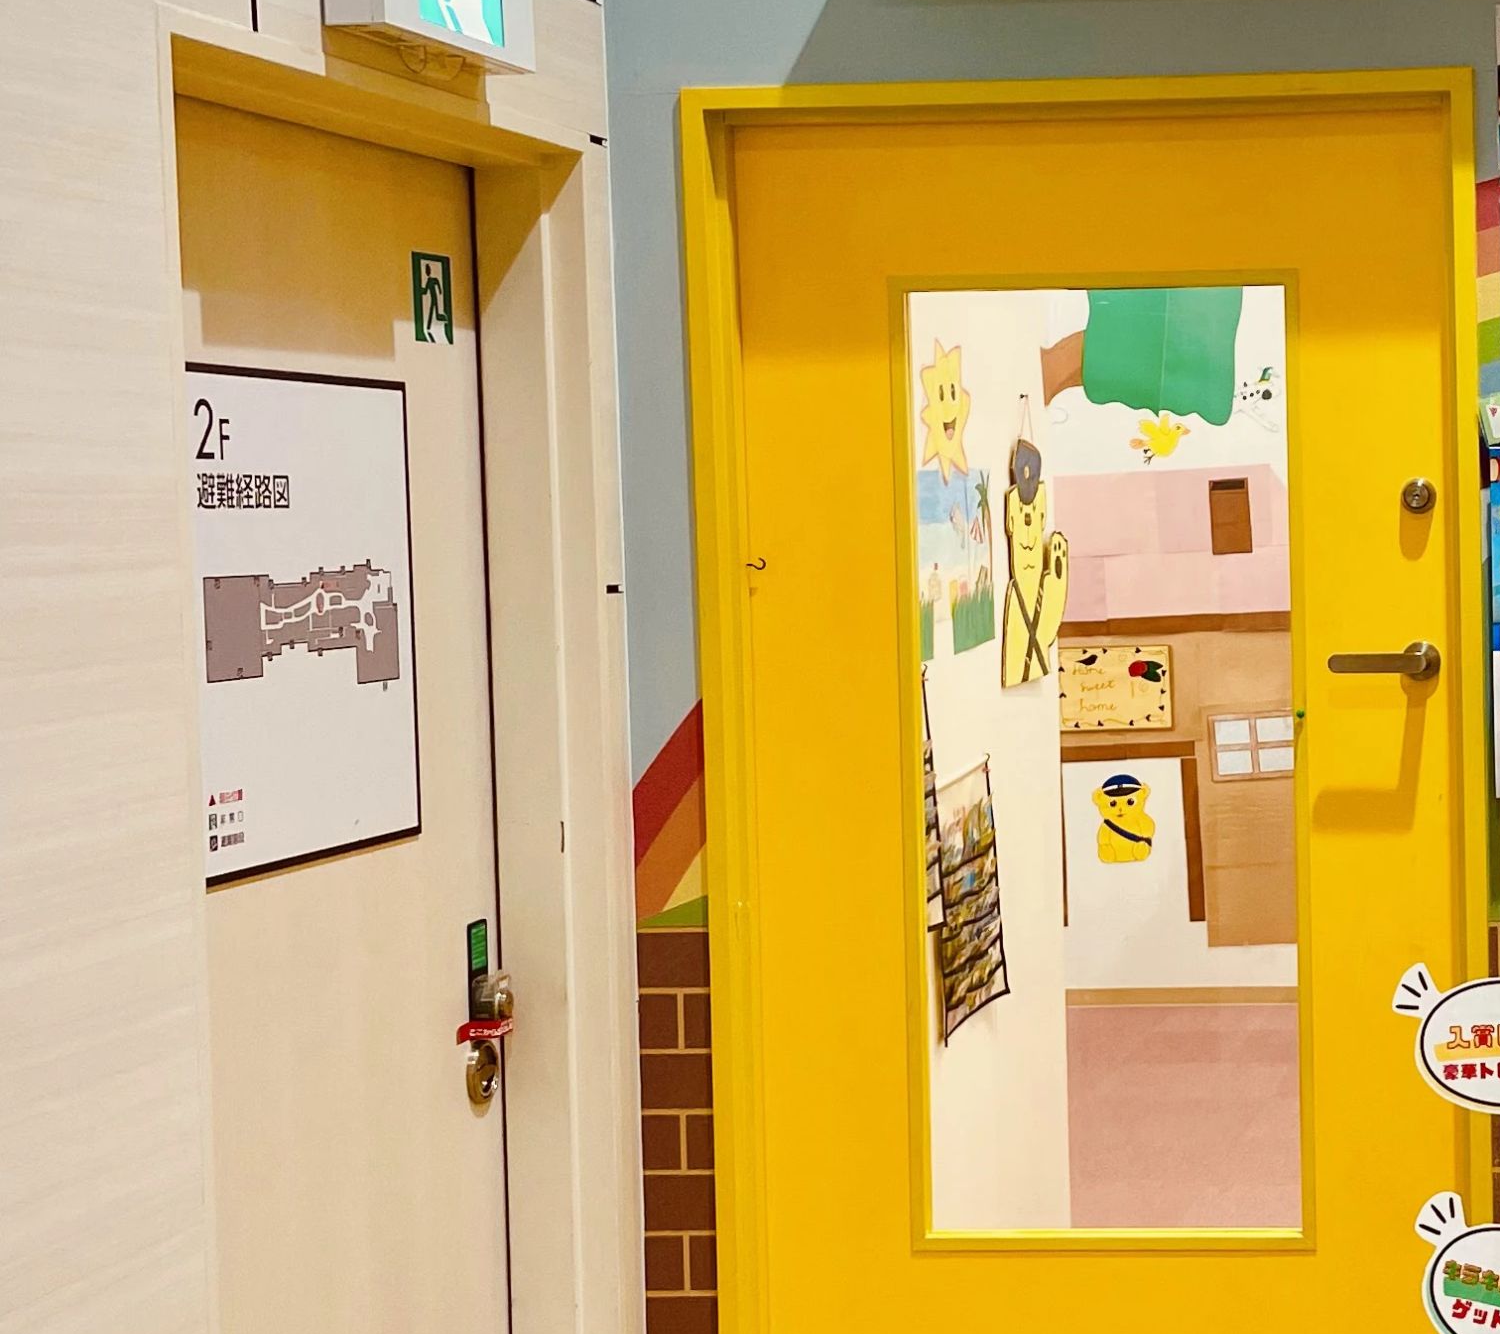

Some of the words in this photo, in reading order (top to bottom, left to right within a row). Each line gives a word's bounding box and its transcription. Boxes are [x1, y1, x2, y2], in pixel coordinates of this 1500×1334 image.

[194, 398, 230, 460] 2F
[197, 473, 290, 509] 避難経路図
